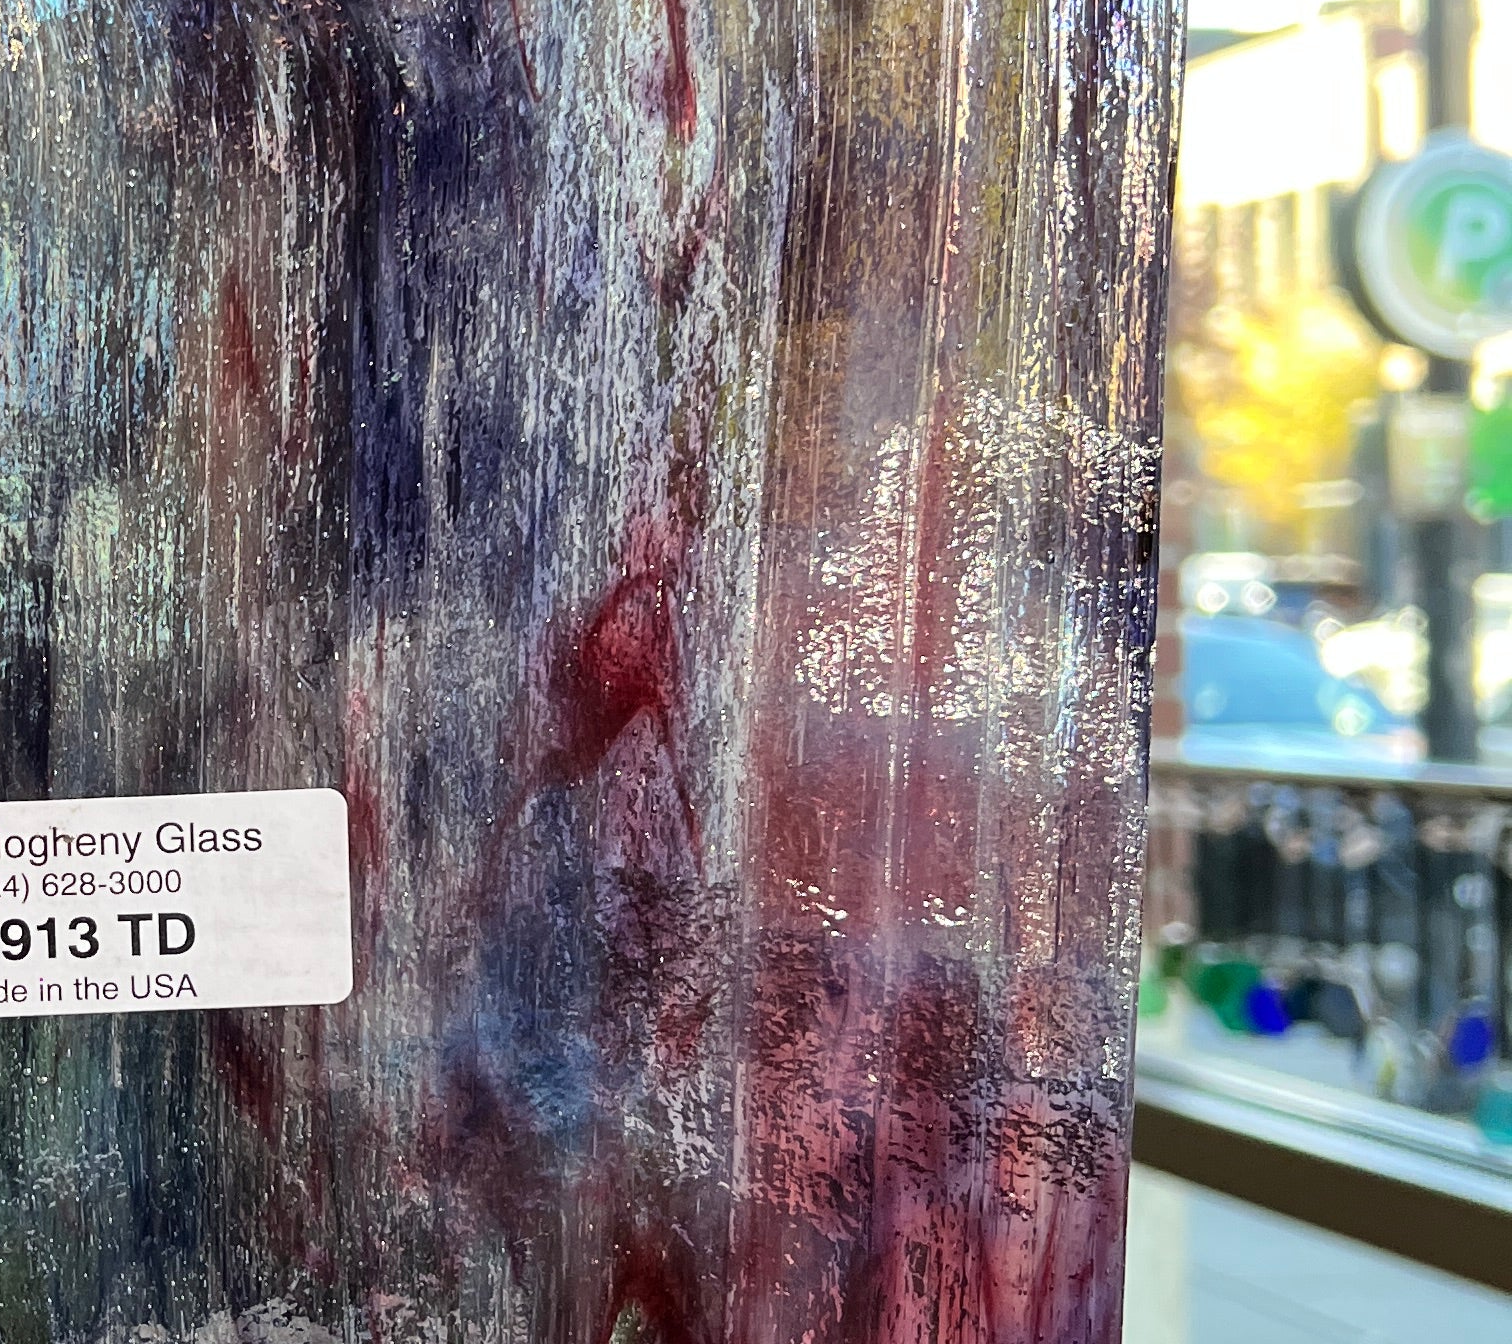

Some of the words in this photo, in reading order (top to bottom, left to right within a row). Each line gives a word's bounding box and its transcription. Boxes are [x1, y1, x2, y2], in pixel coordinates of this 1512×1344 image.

[155, 822, 263, 854] Glass
[41, 869, 182, 898] 628-3000
[0, 915, 100, 961] 913
[117, 912, 196, 957] TD
[39, 977, 64, 1002] in
[73, 976, 121, 1001] the
[130, 974, 198, 999] USA
